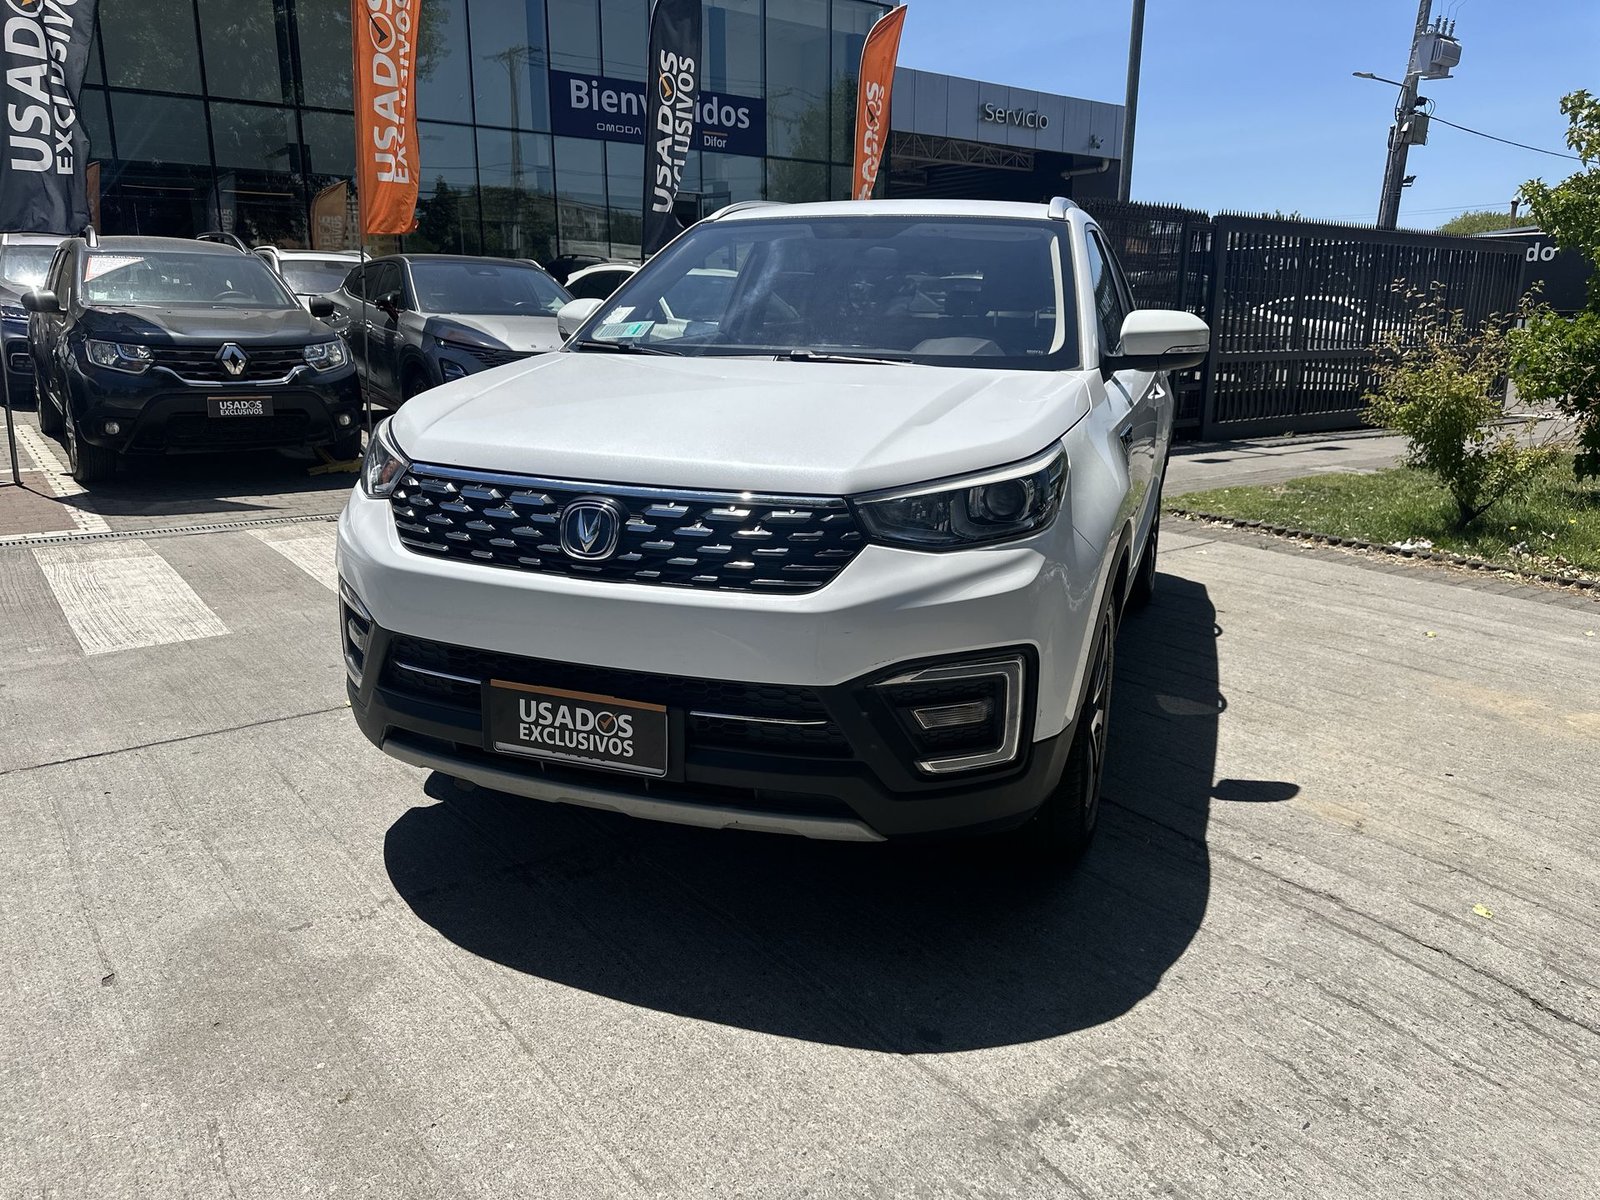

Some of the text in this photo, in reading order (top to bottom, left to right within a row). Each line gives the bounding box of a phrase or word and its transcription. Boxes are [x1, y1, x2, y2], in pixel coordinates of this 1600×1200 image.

[44, 0, 79, 175] EXCLUSIV
[596, 122, 642, 136] OMODA
[985, 102, 1049, 129] Servicio
[651, 49, 678, 213] USADOS
[703, 135, 728, 149] Difor
[219, 400, 263, 410] USADOS
[220, 408, 264, 416] EXCLUSIVOS
[519, 698, 634, 738] USADOS
[519, 722, 634, 757] EXCLUSIVOS
